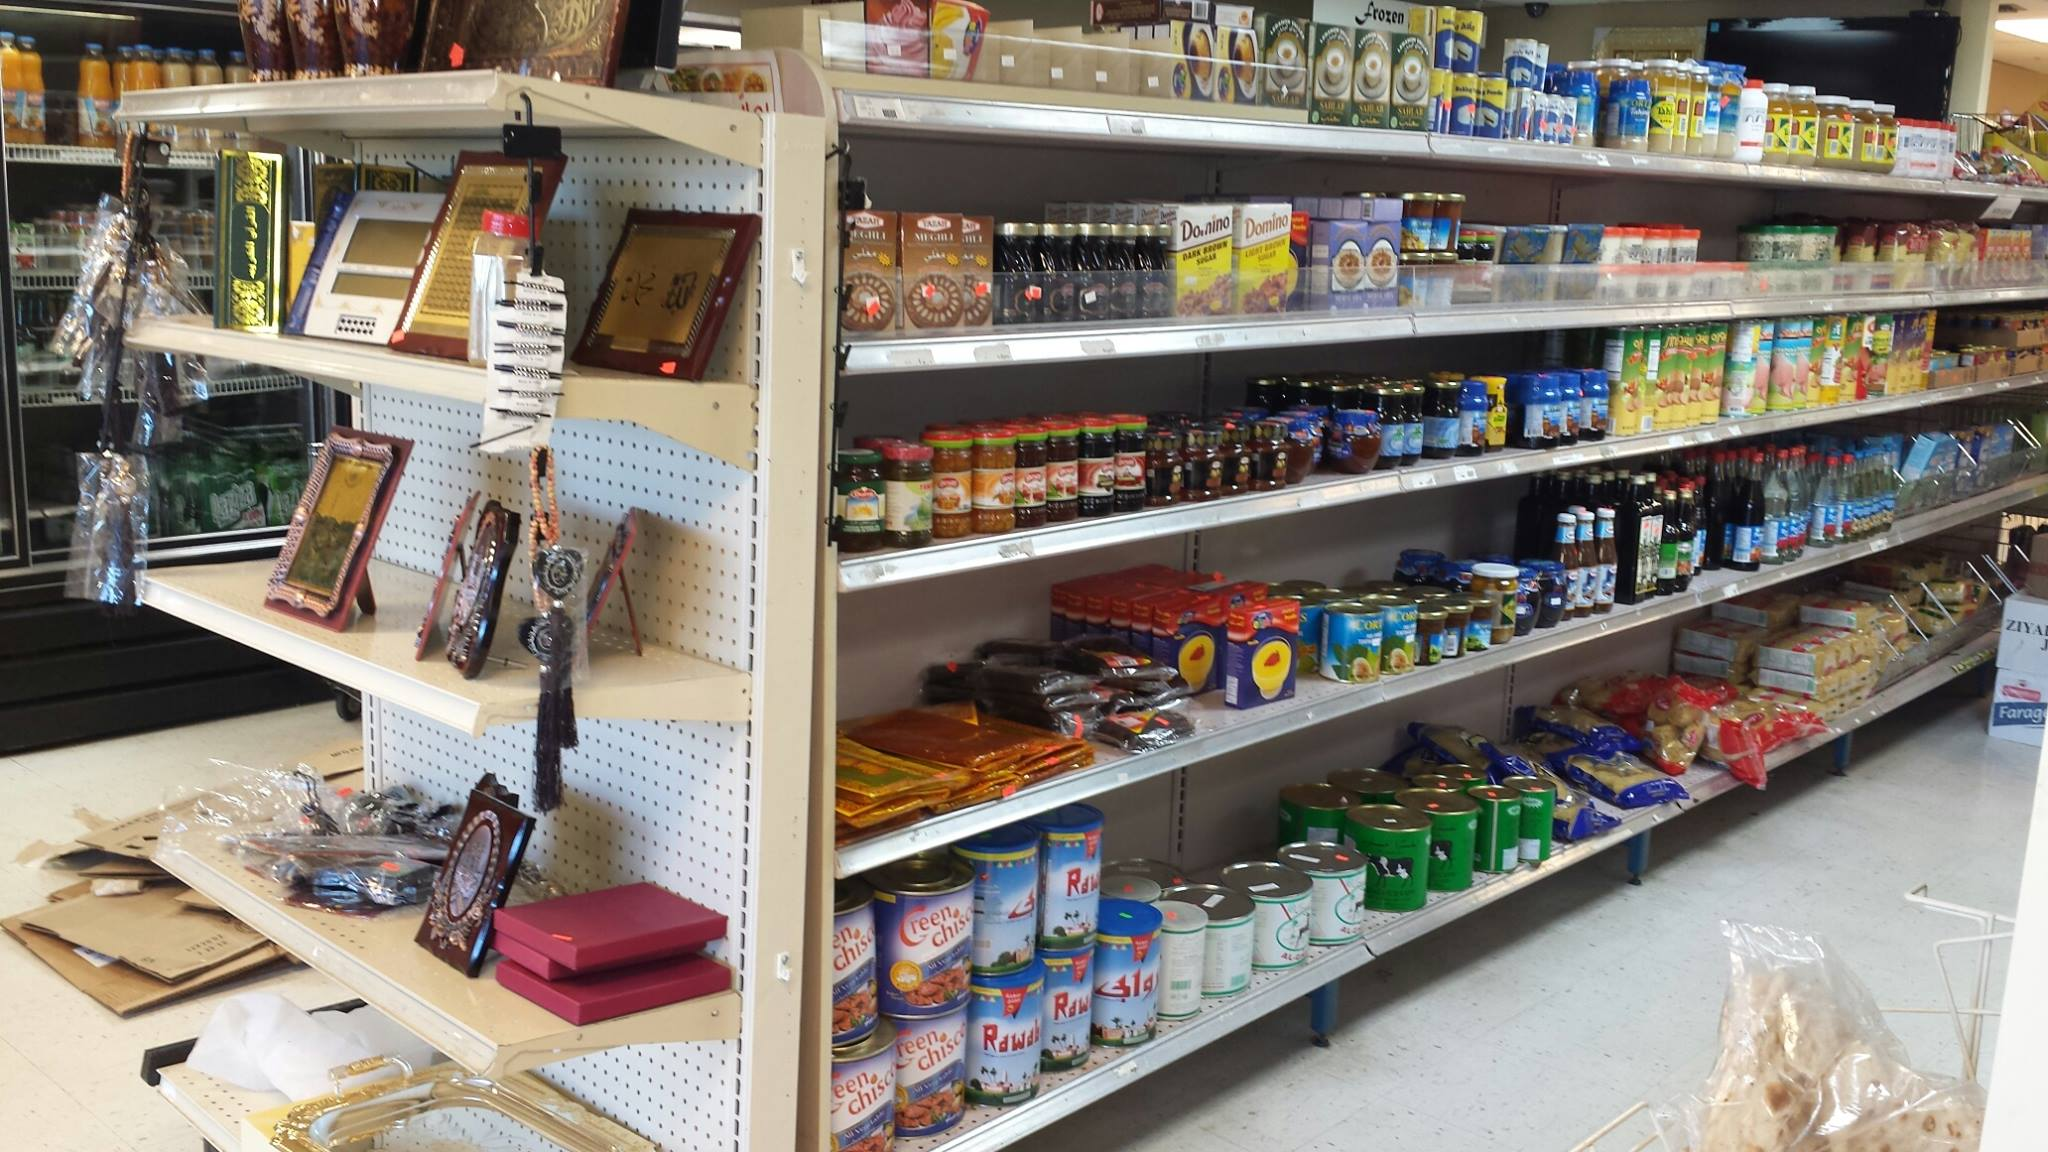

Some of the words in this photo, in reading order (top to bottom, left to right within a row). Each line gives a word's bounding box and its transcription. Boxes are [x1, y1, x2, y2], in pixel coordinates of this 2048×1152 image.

[1355, 1, 1404, 26] Frozen
[1181, 216, 1231, 242] Domino
[1244, 212, 1289, 240] Domino
